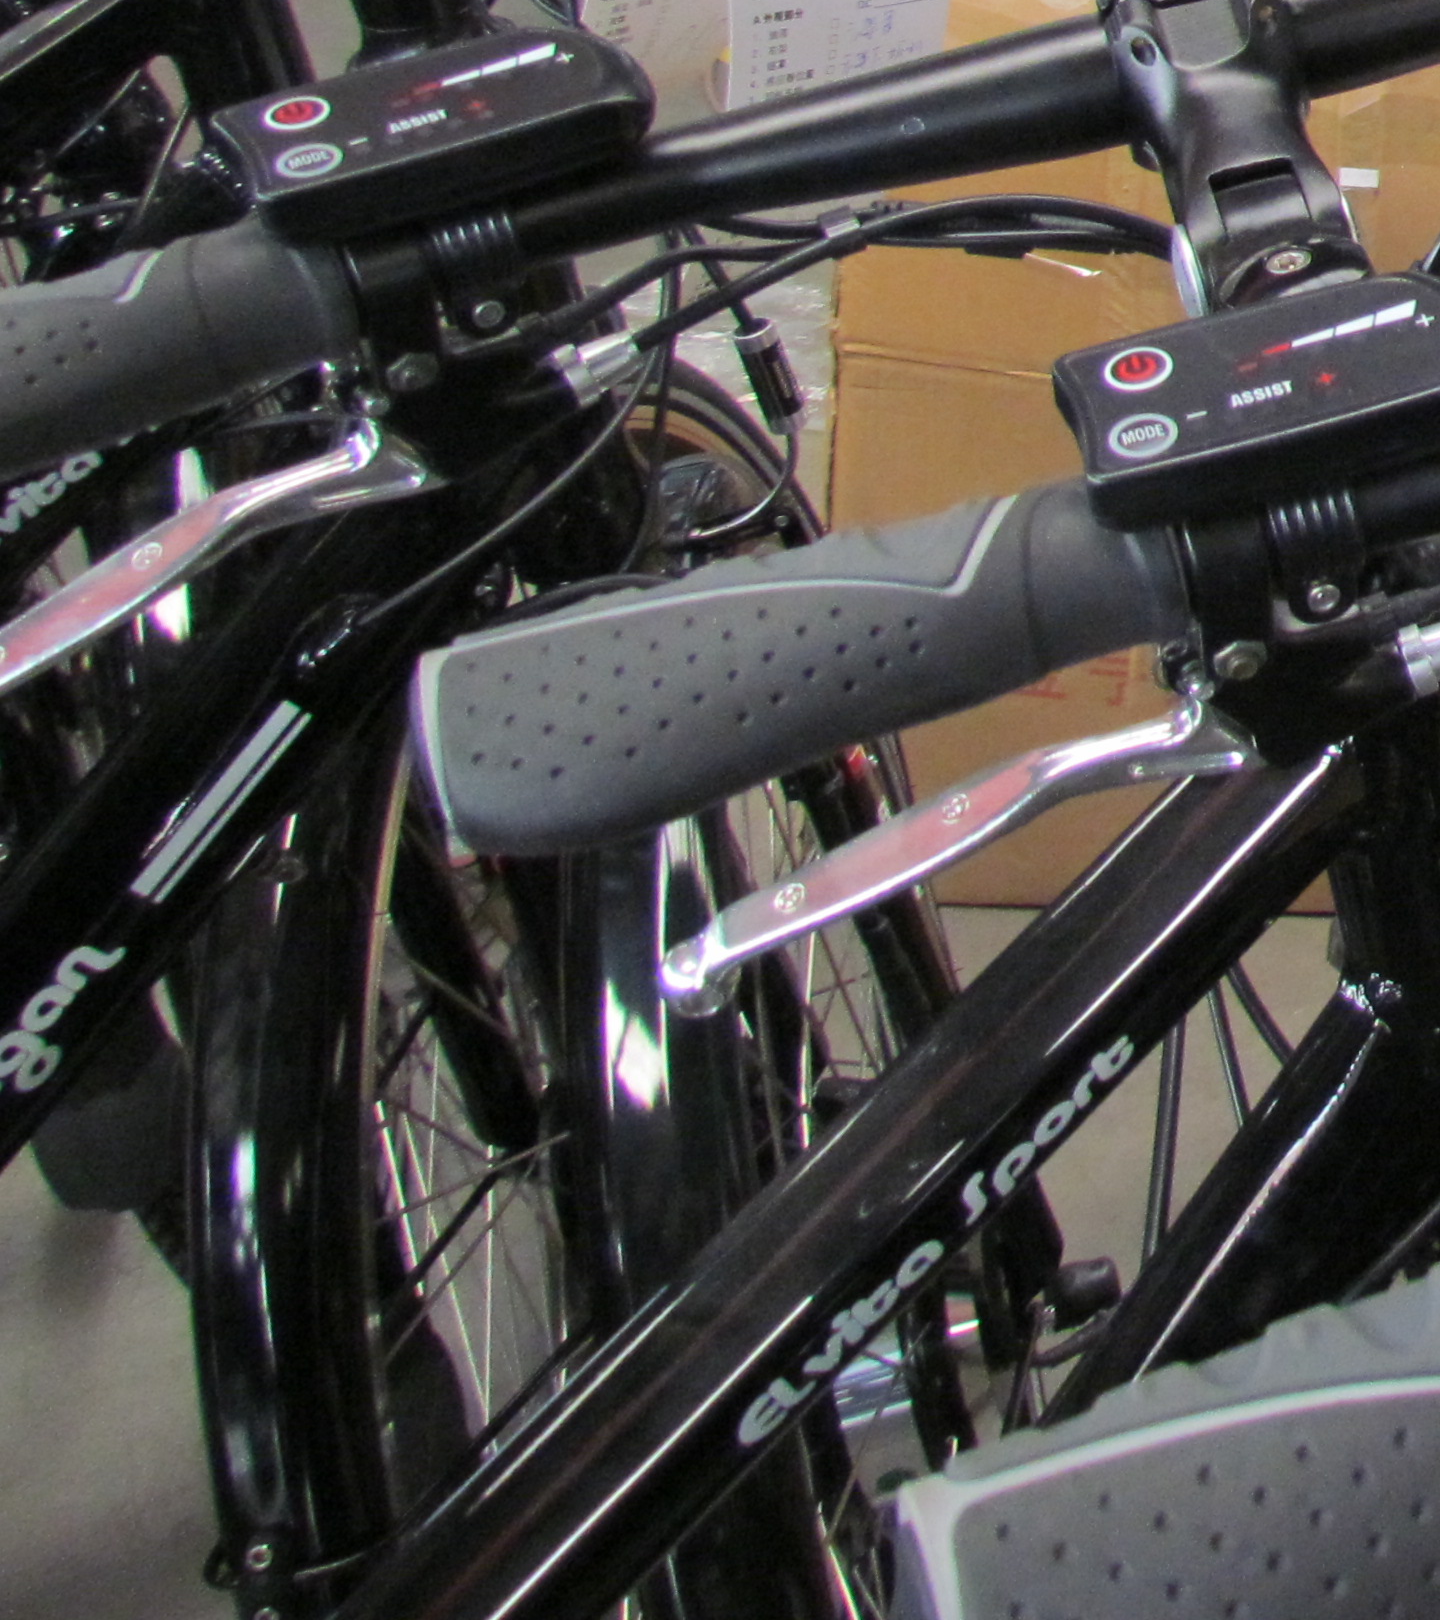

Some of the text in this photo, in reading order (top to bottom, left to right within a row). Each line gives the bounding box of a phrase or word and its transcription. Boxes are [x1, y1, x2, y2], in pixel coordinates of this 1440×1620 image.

[389, 109, 448, 134] ASSIST
[287, 151, 331, 170] MODE
[1230, 380, 1293, 408] ASSIST
[1120, 424, 1165, 447] MODE
[962, 1034, 1135, 1225] Sport
